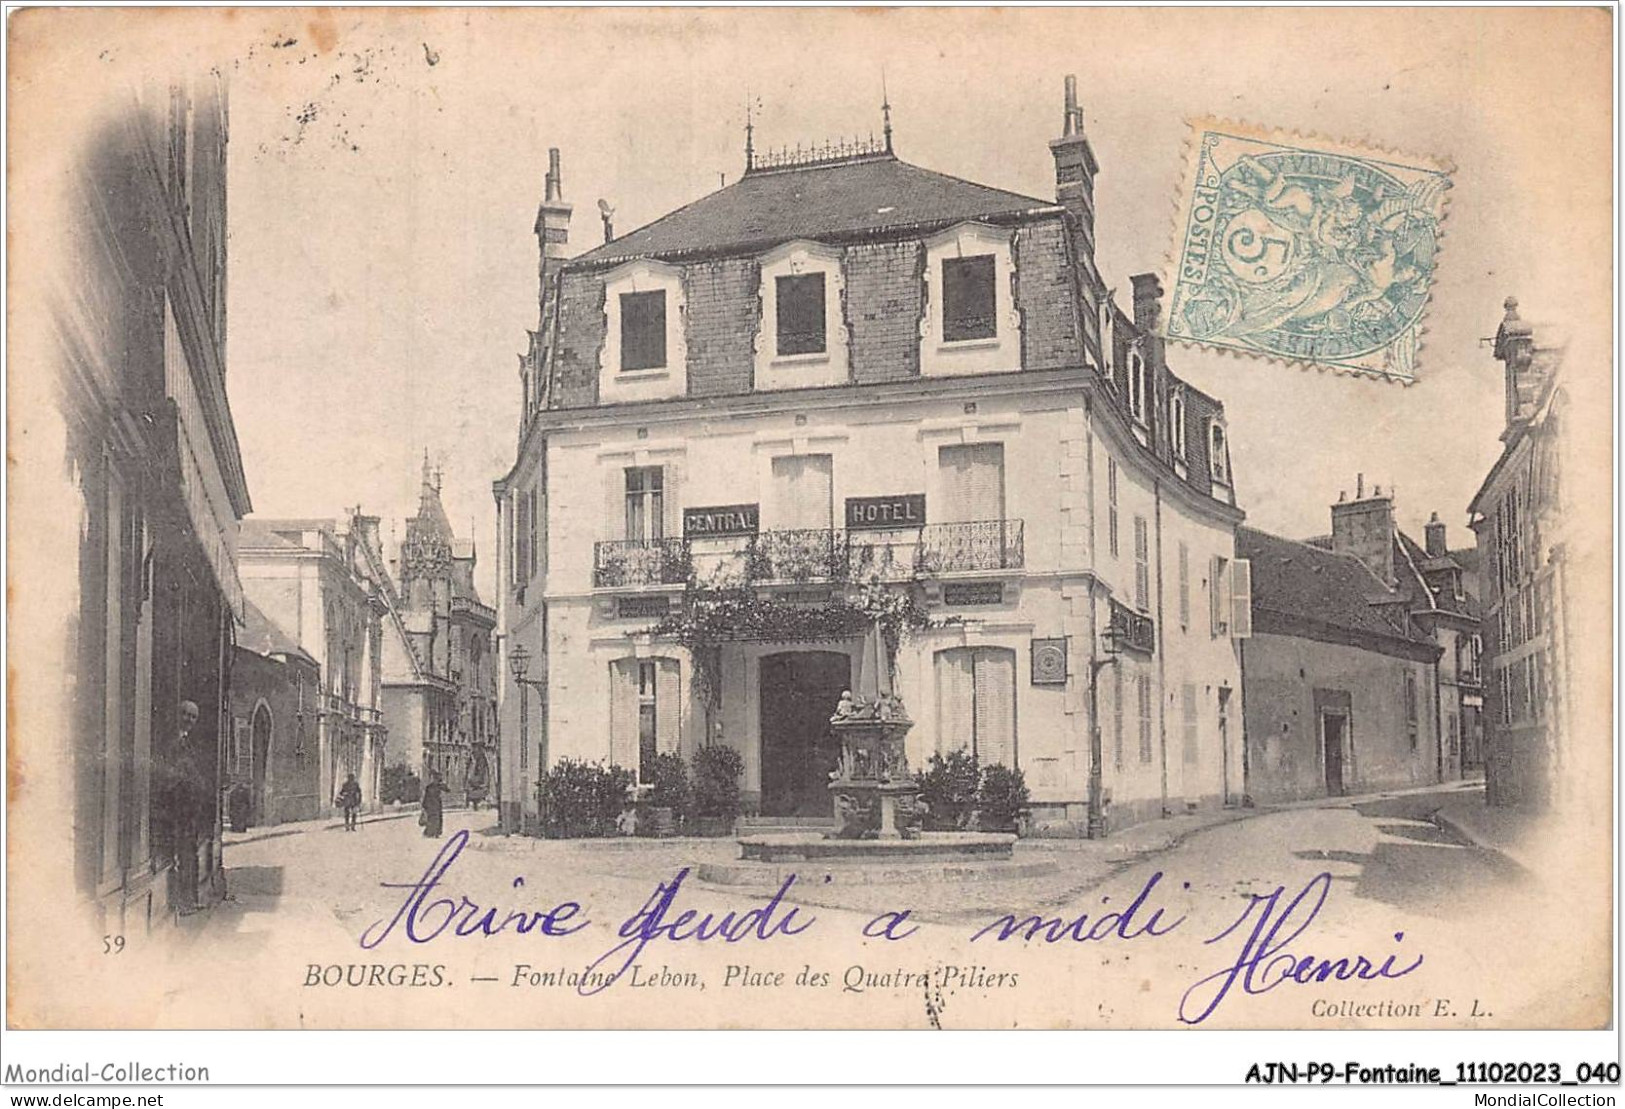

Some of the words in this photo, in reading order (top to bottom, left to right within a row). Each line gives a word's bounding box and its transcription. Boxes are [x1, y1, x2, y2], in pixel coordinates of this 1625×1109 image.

[1184, 189, 1217, 279] POSTES
[686, 512, 756, 533] CENTRAL
[852, 501, 918, 523] HOTEL
[970, 871, 1191, 943] midi
[1179, 872, 1424, 1025] Henri
